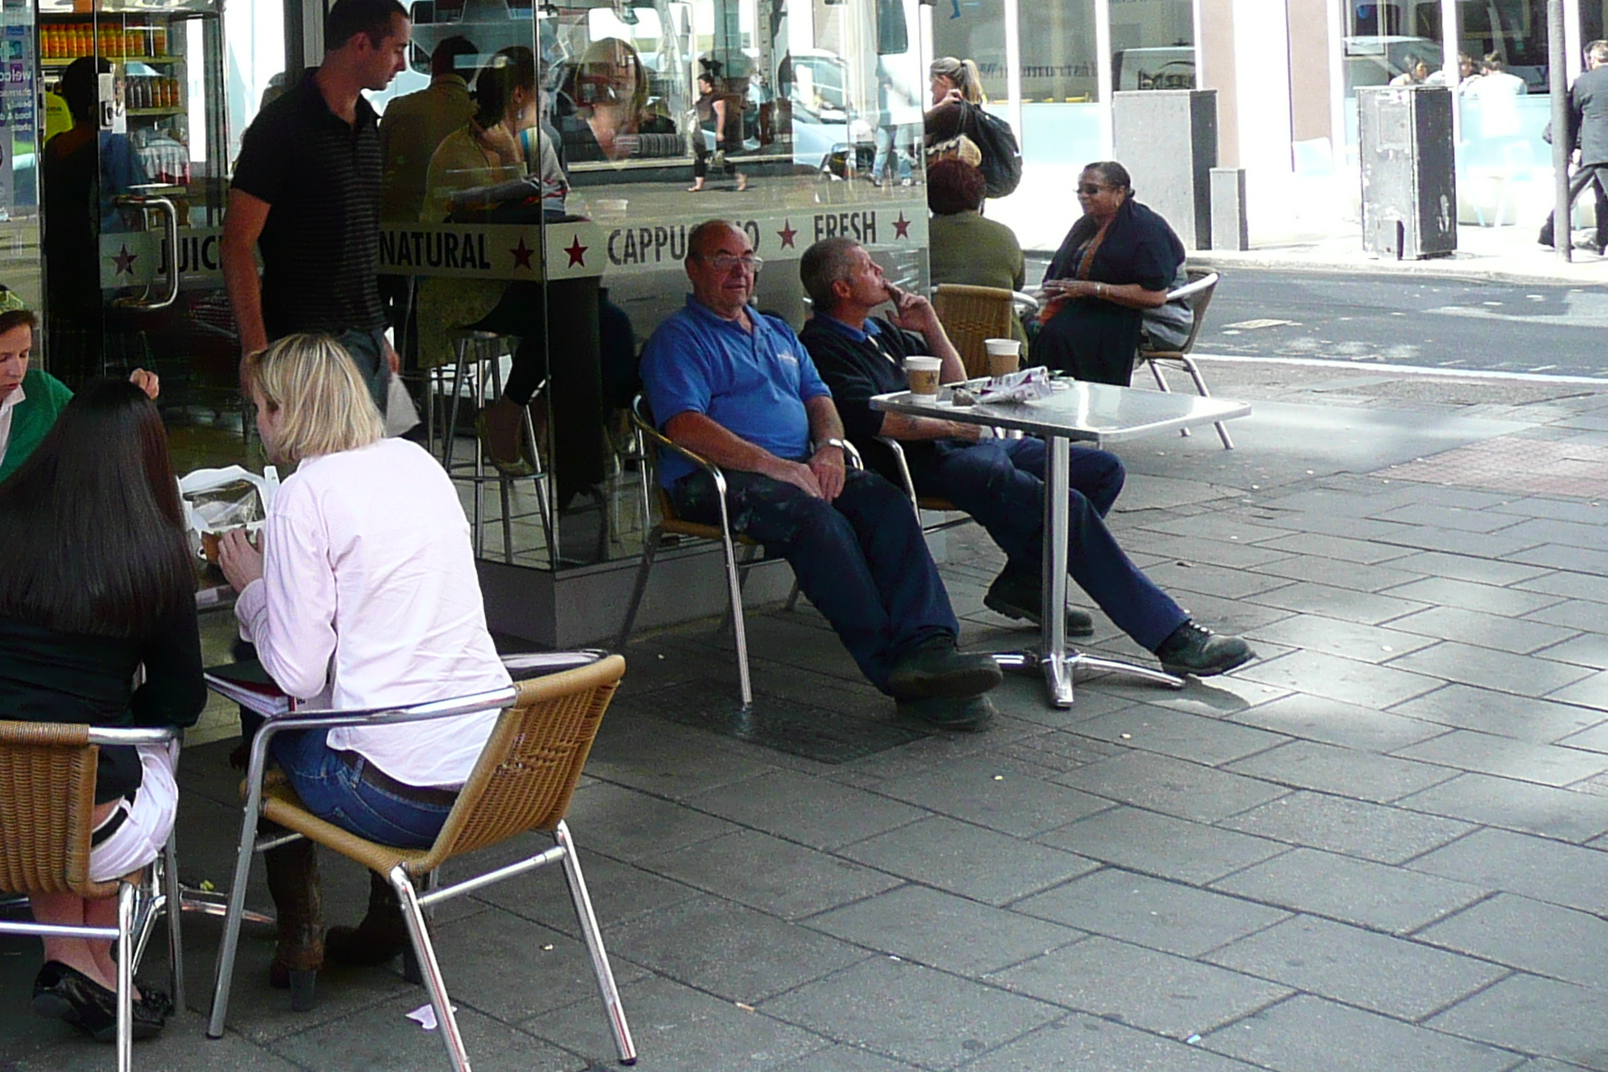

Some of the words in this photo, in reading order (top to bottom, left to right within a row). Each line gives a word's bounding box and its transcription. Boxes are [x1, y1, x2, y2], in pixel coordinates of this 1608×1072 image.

[158, 234, 225, 275] JUIC
[379, 231, 492, 270] NATURAL
[606, 220, 761, 265] CAPPUO
